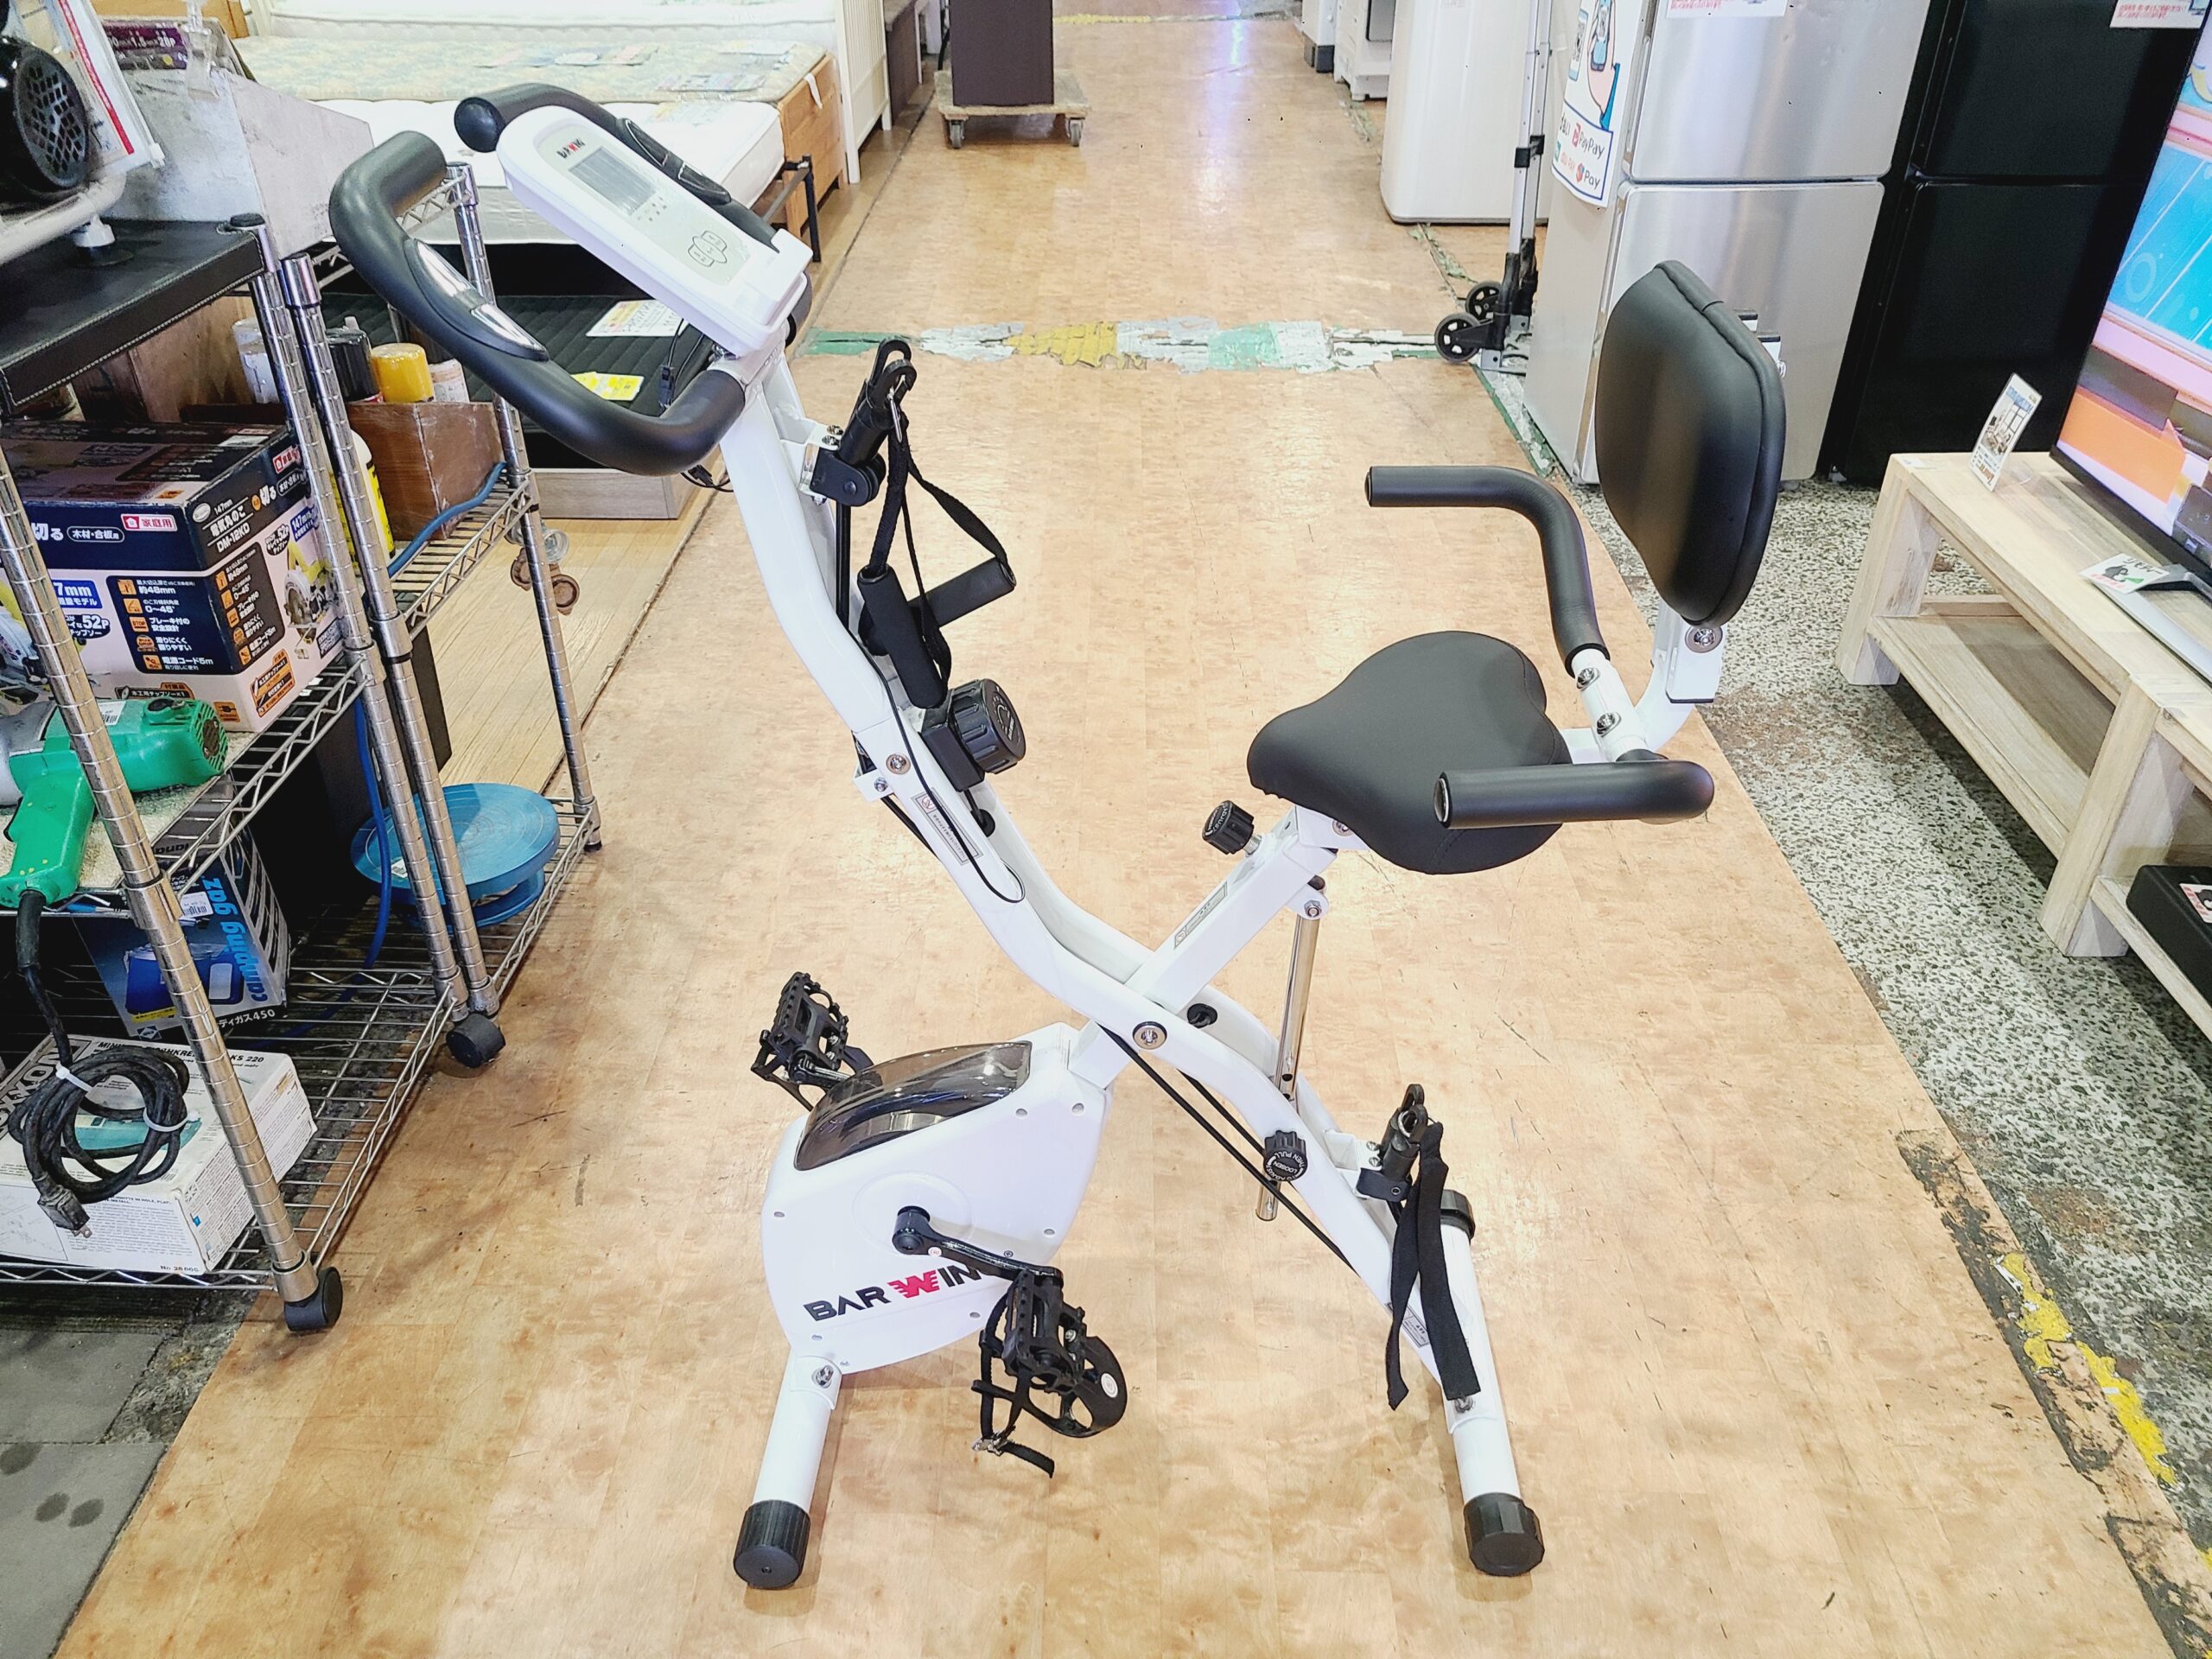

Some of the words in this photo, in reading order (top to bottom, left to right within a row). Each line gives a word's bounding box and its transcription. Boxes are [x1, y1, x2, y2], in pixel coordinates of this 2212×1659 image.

[1580, 130, 1605, 160] PayPay
[143, 518, 173, 528] 家庭用
[82, 614, 109, 629] 52P
[202, 876, 238, 916] gaz
[220, 921, 268, 1002] camping
[1273, 1160, 1298, 1173] LOOSEN
